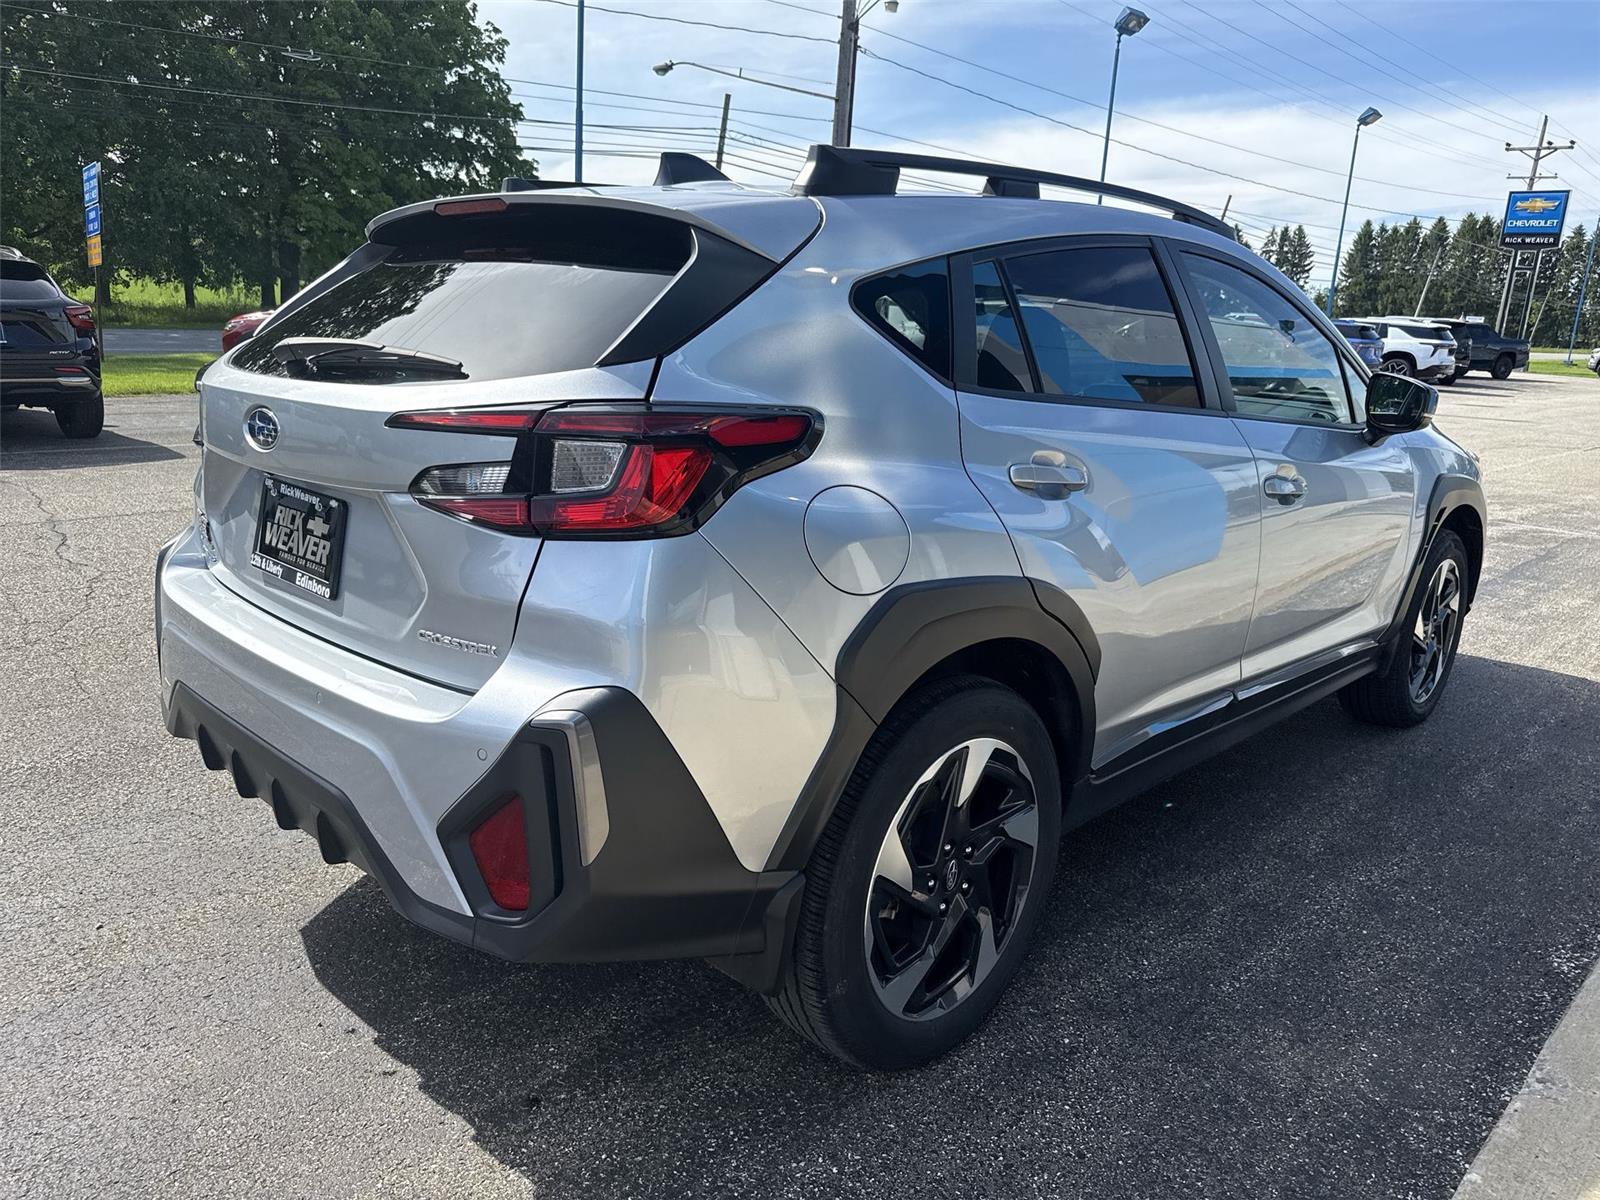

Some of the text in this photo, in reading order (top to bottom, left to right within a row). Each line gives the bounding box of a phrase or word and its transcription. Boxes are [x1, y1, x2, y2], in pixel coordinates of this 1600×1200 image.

[1507, 219, 1559, 227] CHEVROLET
[274, 505, 305, 531] RICK
[264, 521, 331, 566] WEAVER
[266, 559, 284, 578] Liberty
[279, 550, 326, 574] FAMOUS FOR SERVICE
[295, 572, 331, 599] Edinboro
[417, 629, 498, 658] CROSSTREK
